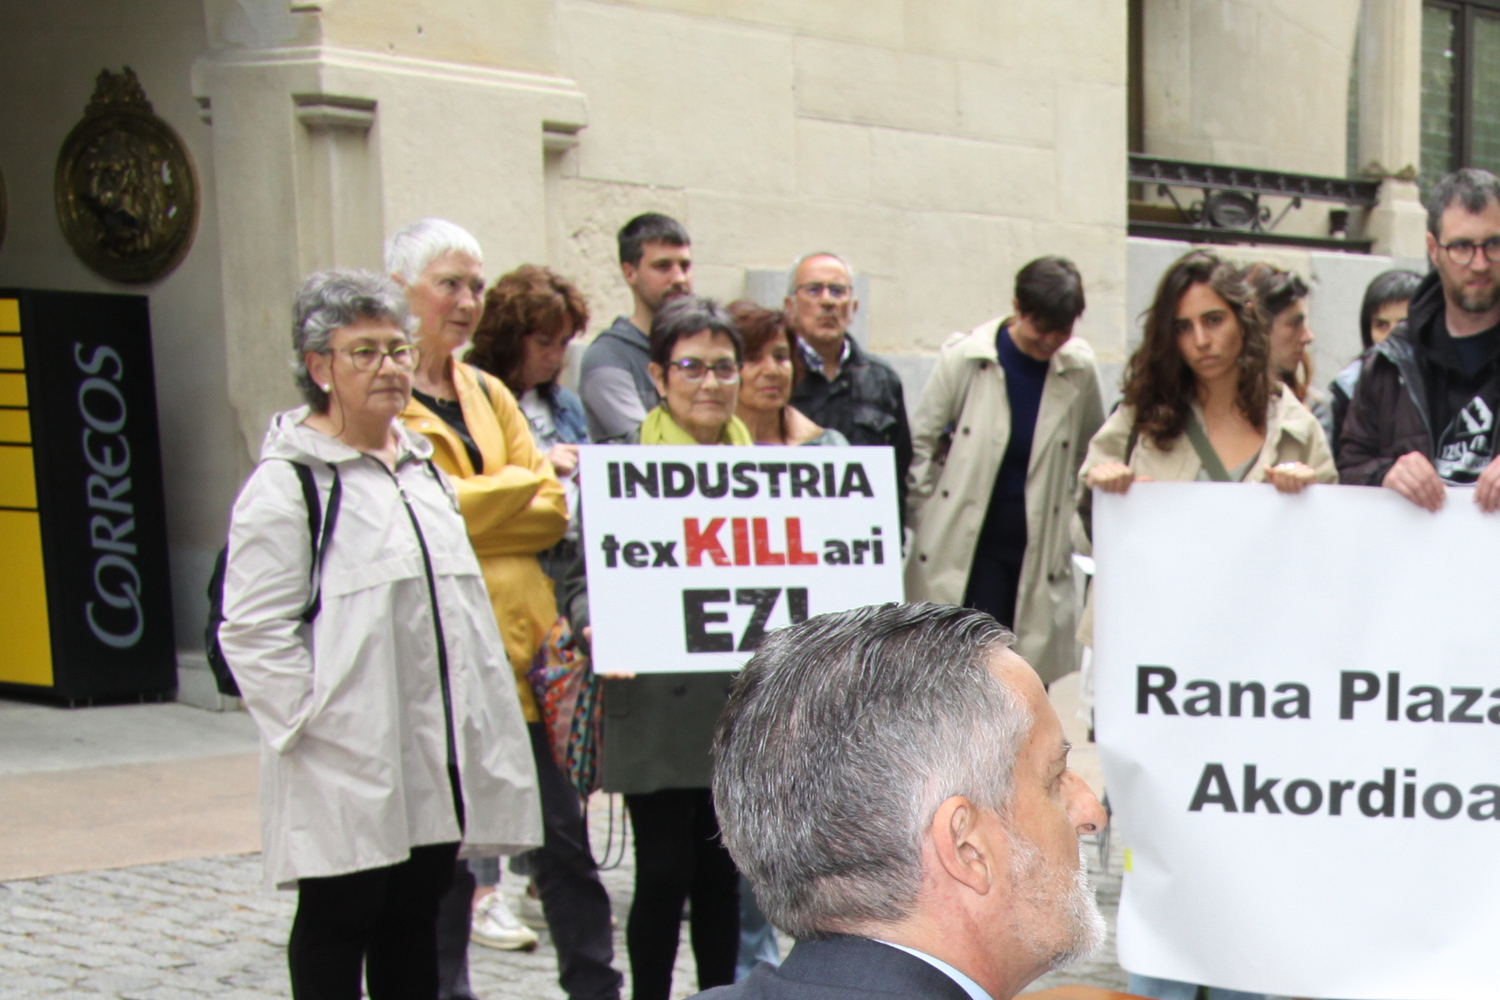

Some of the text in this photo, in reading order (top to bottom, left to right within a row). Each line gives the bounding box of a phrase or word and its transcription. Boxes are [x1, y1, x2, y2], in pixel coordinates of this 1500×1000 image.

[74, 341, 145, 649] CORREOS
[606, 461, 875, 499] INDUSTRIA
[1135, 664, 1312, 720] Rana
